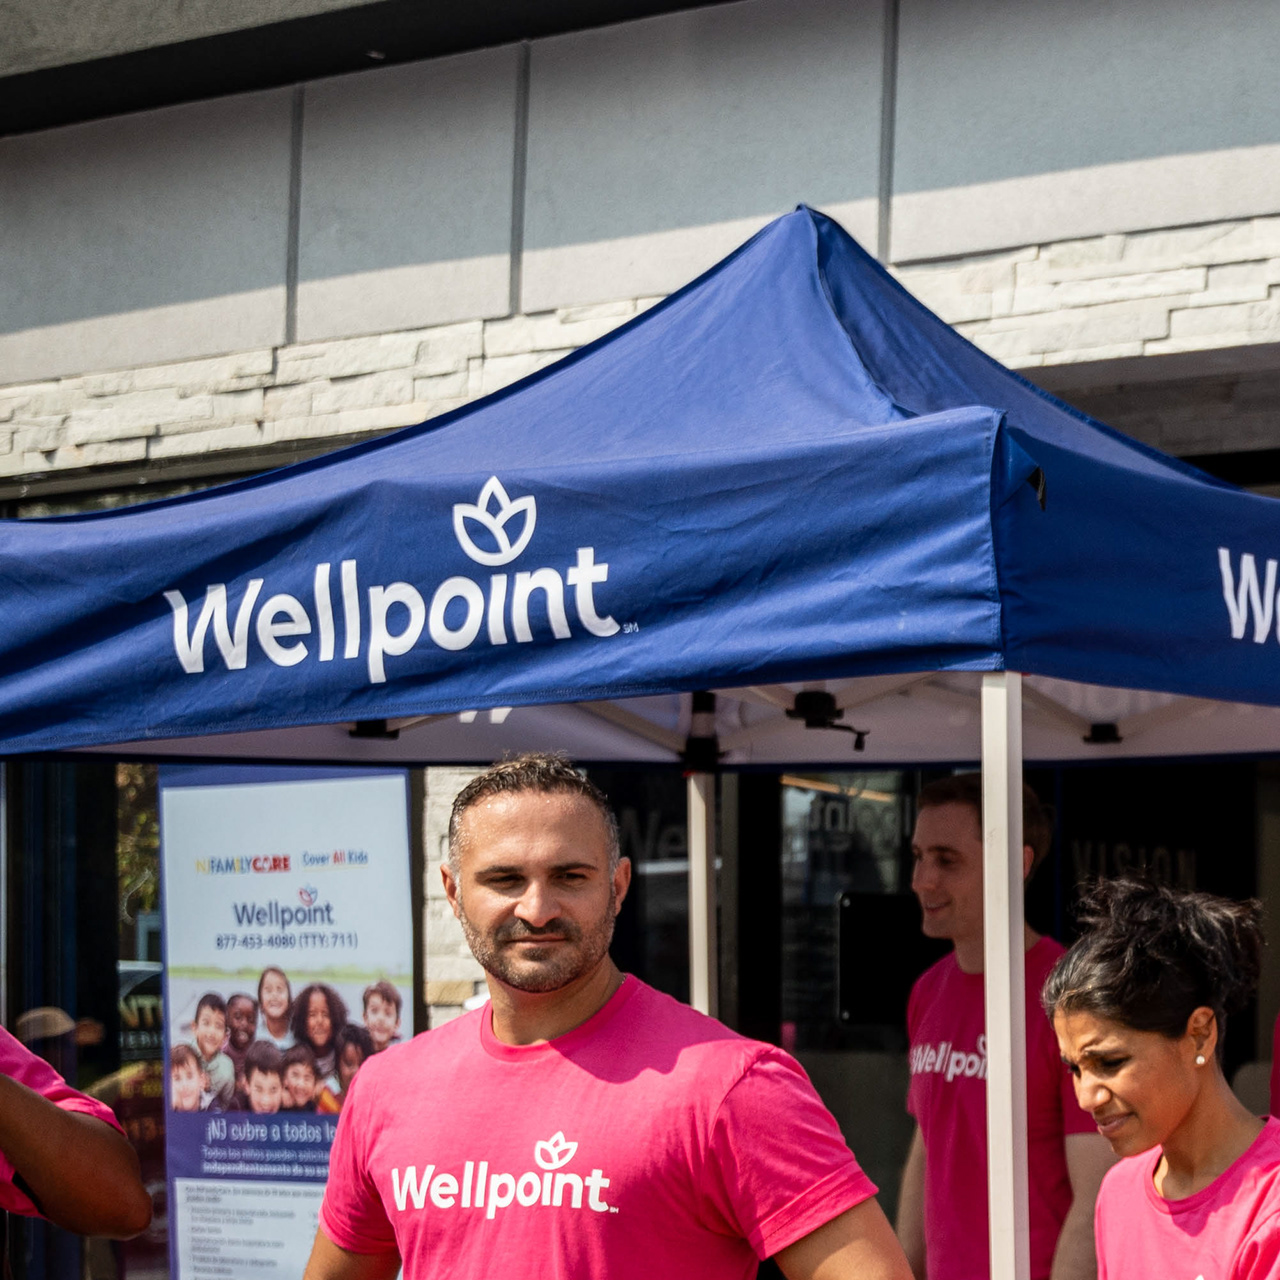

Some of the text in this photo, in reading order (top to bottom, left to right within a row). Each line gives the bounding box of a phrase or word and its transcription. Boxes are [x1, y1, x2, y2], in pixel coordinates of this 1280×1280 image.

[163, 547, 621, 684] Wellpoint
[303, 851, 331, 866] Cover
[333, 850, 346, 865] All
[348, 850, 368, 865] Kids
[234, 901, 334, 930] Wellpoint
[910, 1041, 988, 1082] Wellpoi
[231, 1119, 268, 1142] cubre
[270, 1124, 281, 1142] a
[283, 1121, 322, 1143] todos
[391, 1160, 611, 1220] Wellpoint
